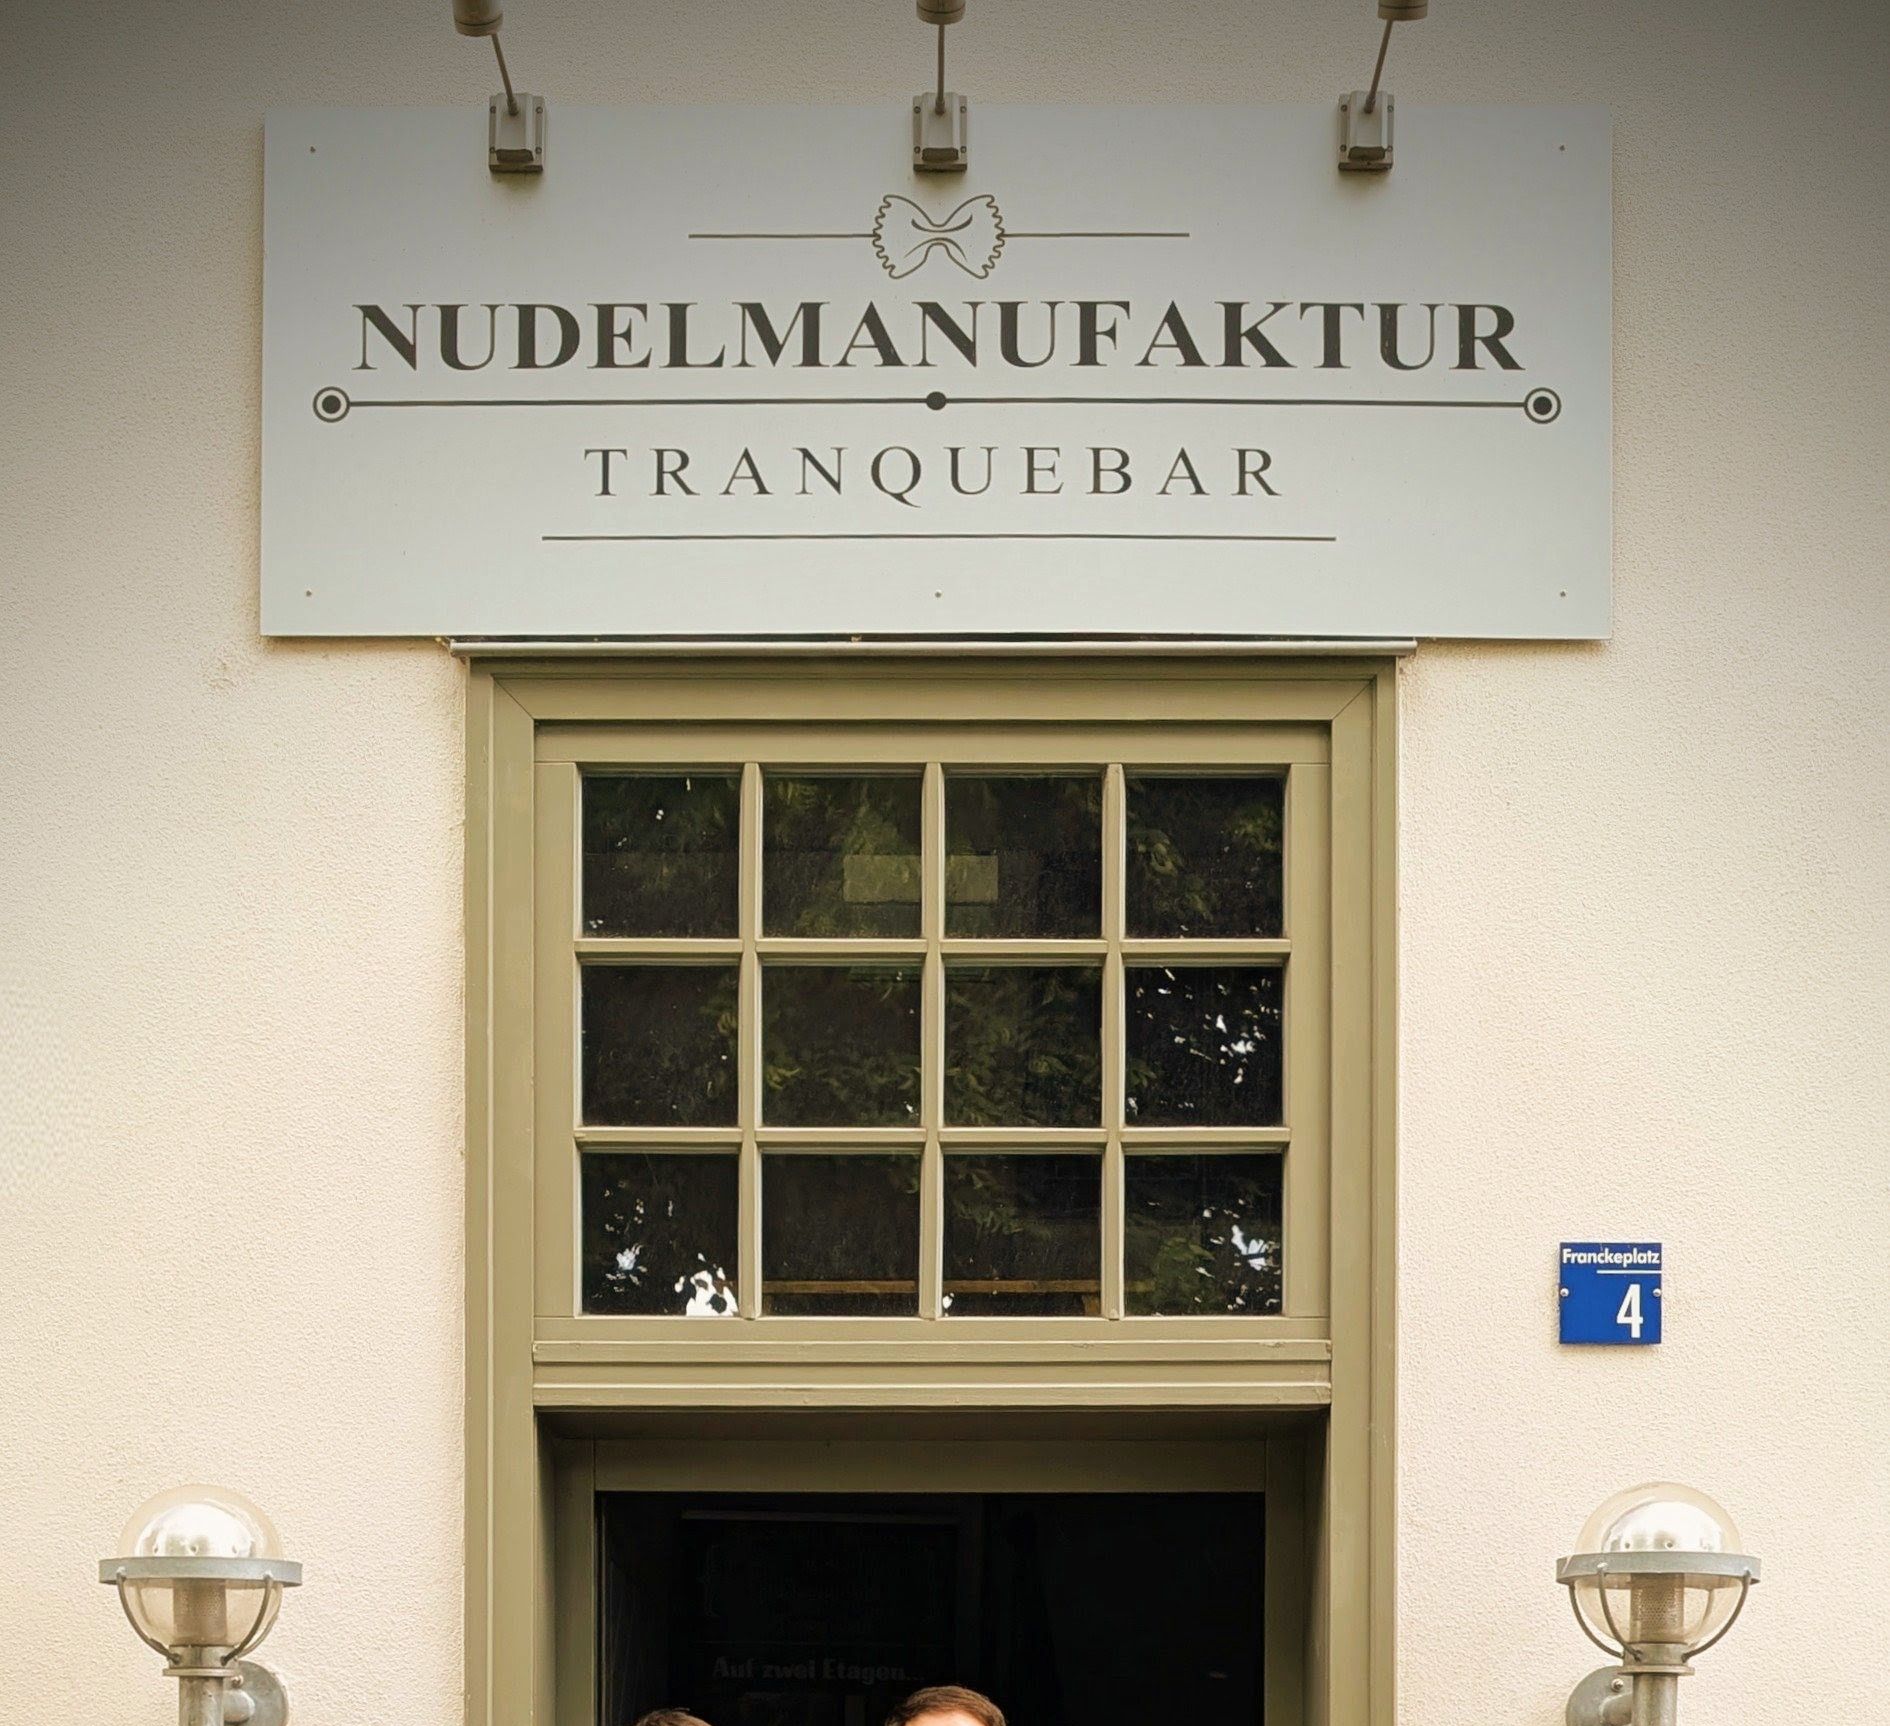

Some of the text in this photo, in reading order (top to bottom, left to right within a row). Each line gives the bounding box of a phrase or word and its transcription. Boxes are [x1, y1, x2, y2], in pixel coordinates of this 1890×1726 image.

[351, 300, 1526, 371] NUDELMANUFAKTUR
[584, 446, 1283, 508] TRANQUEBAR
[1562, 1247, 1660, 1268] Franckeplatz
[1616, 1283, 1644, 1339] 4
[712, 1656, 756, 1680] Auf
[761, 1658, 816, 1680] zwei
